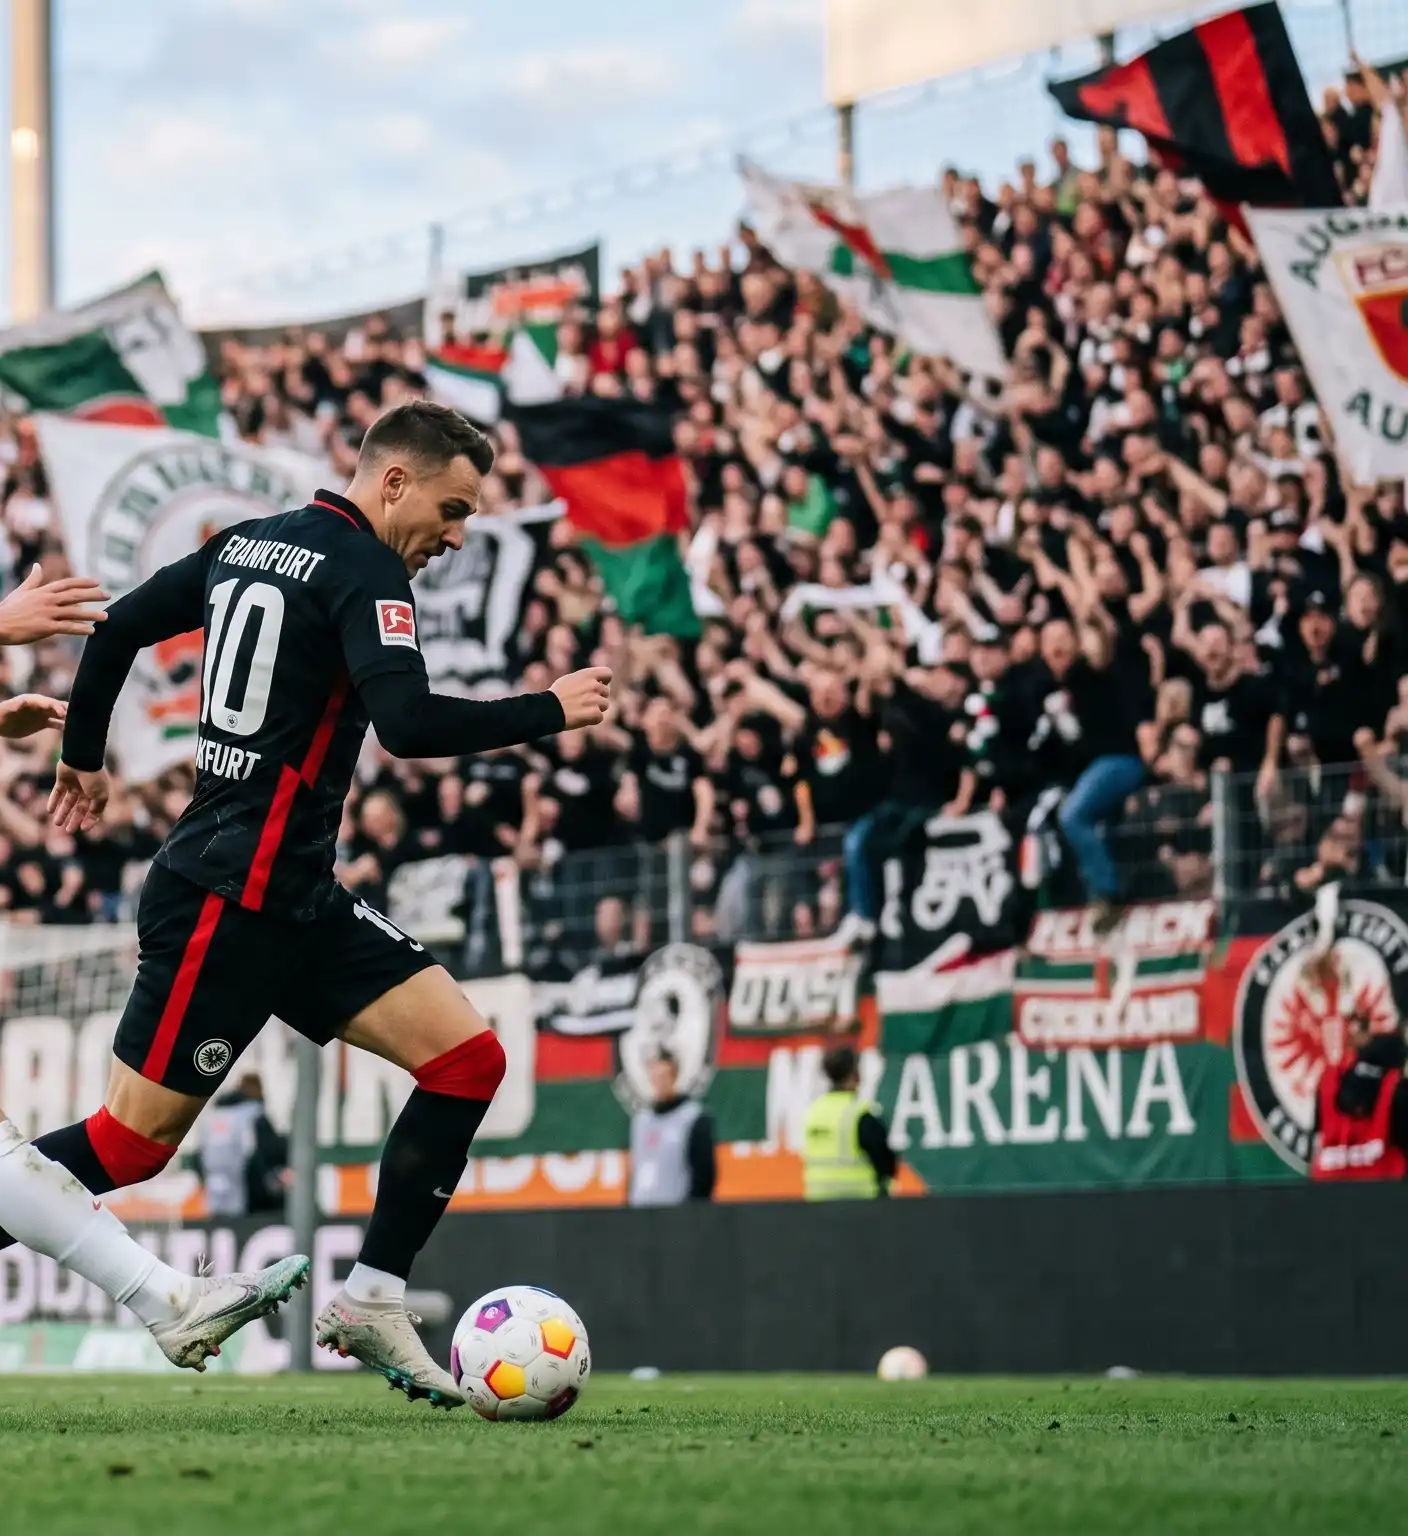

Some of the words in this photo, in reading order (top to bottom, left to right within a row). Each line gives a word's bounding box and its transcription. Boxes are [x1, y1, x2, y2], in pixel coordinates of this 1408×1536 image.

[218, 534, 326, 583] FRANKFURT
[201, 578, 285, 736] 10
[888, 1038, 1196, 1151] ARENA
